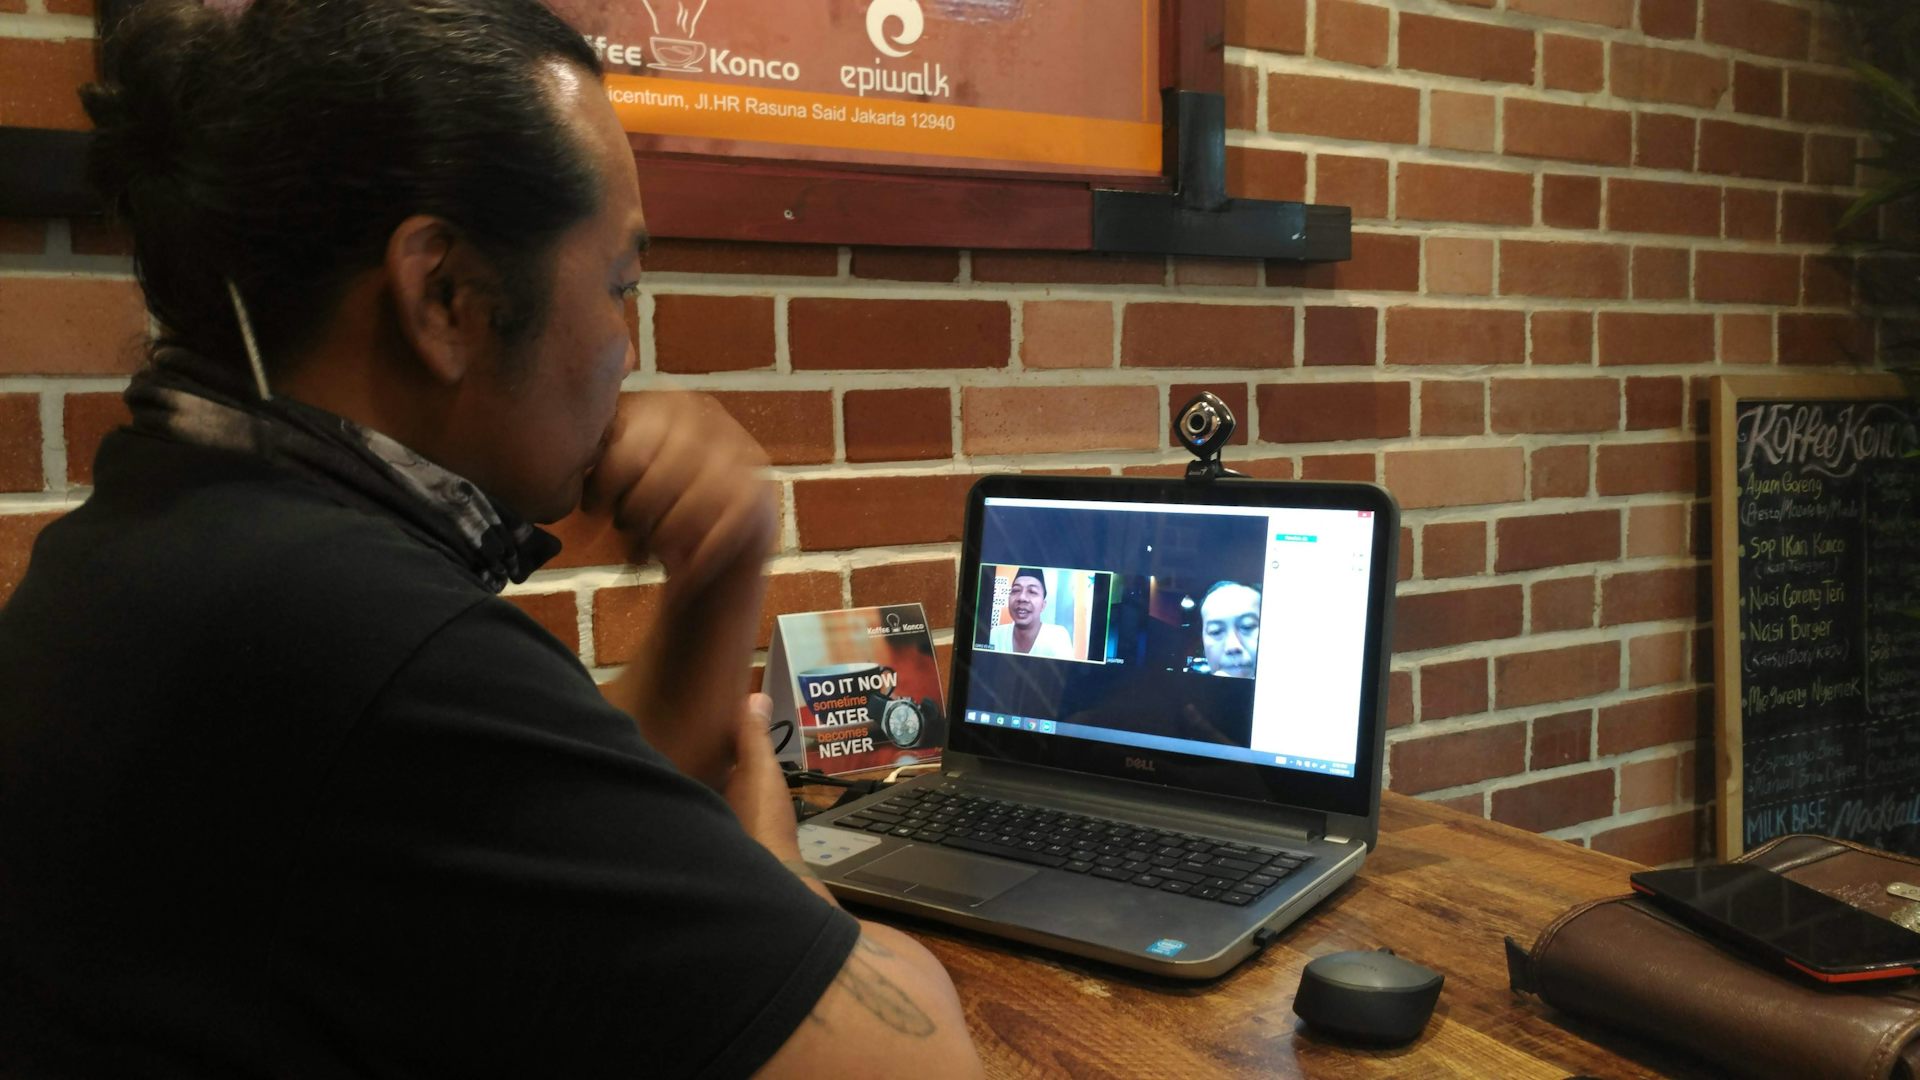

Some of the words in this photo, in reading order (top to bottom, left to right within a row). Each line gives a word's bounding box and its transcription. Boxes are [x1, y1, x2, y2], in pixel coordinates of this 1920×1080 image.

[709, 48, 800, 81] Konco
[840, 58, 950, 98] epiwalk
[608, 85, 688, 111] icentrum,
[745, 98, 807, 119] Rasuna
[812, 104, 847, 122] Said
[851, 107, 906, 127] Jakarta
[911, 113, 956, 132] 12940
[1747, 472, 1780, 499] Ayam
[1782, 471, 1822, 499] Goreng
[1750, 536, 1776, 559] Sop
[1749, 585, 1780, 614] Nasi
[1783, 583, 1821, 610] Goreng
[1821, 579, 1845, 604] Teri
[902, 623, 925, 631] Konco
[1749, 617, 1784, 642] Nasi
[1788, 614, 1833, 640] Burger
[809, 680, 835, 698] DO
[838, 678, 854, 694] IT
[858, 672, 897, 692] NOW
[813, 694, 868, 711] sometime
[815, 707, 871, 728] LATER
[818, 726, 869, 743] becomes
[819, 737, 874, 759] NEVER
[1126, 757, 1156, 771] DELL
[1747, 808, 1788, 844] MILK
[1792, 798, 1826, 833] BASE
